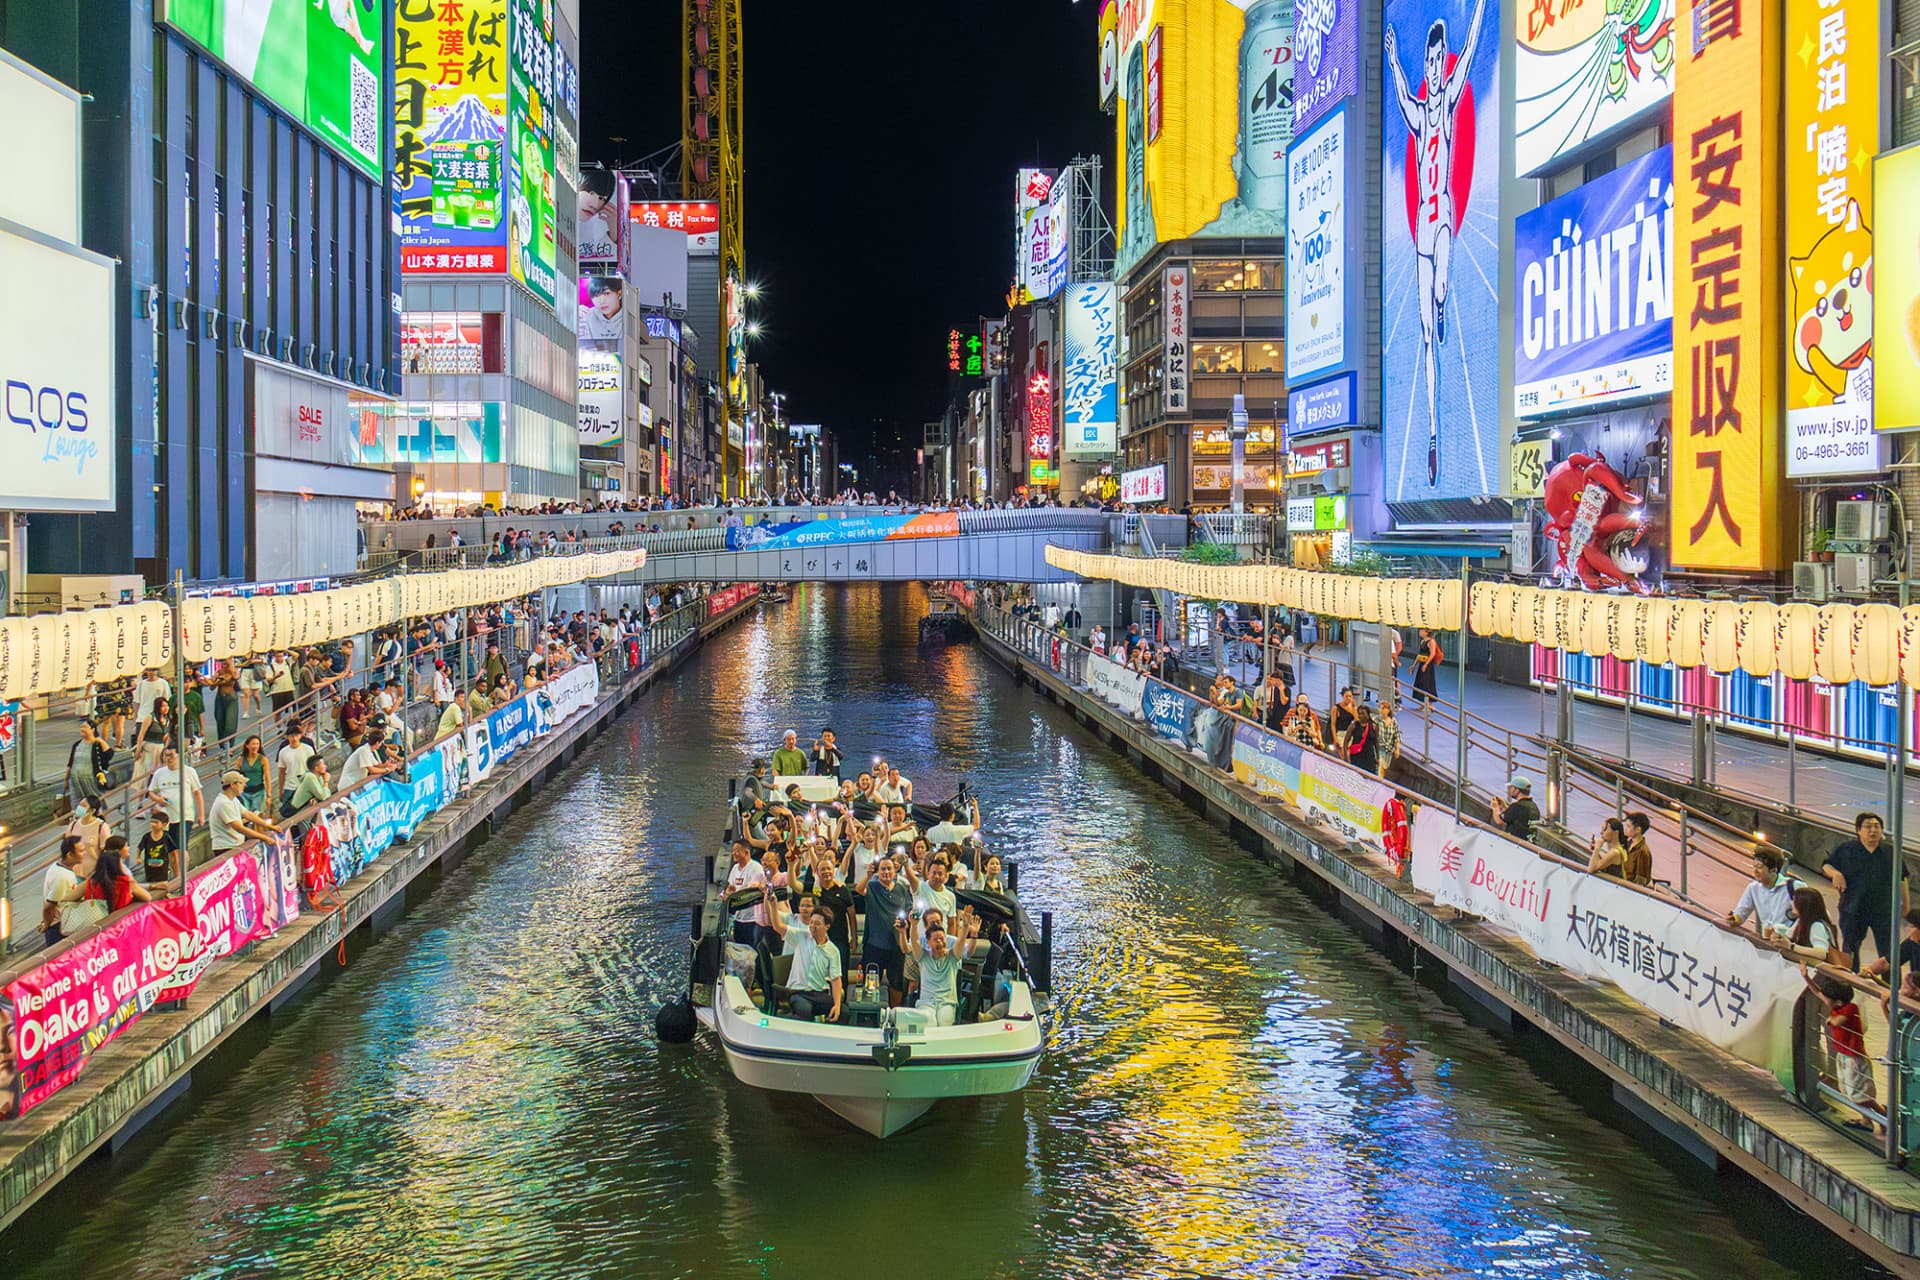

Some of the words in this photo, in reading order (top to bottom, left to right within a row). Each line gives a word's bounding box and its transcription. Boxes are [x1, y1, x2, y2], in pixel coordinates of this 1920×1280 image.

[467, 0, 505, 82] ぱれ
[435, 160, 489, 179] 大麦若葉
[1293, 132, 1339, 183] 創業100周年
[1427, 126, 1441, 224] グリコ
[643, 211, 684, 228] 免税
[407, 254, 494, 268] 山本漢方製薬
[1690, 110, 1742, 547] 安定収入
[299, 405, 322, 425] SALE
[1797, 415, 1869, 438] www.jsv.jp
[42, 421, 98, 475] Lounge
[1661, 437, 1668, 476] 2F
[1795, 441, 1870, 461] 06-4963-3661
[783, 559, 868, 572] えびす橋
[117, 617, 125, 670] PABLO
[140, 615, 148, 666] PABLO
[162, 610, 170, 659] PABLO
[203, 606, 212, 653] PABLO
[228, 605, 237, 650] PABLO
[1440, 840, 1465, 879] 美
[73, 968, 87, 986] to
[1566, 905, 1752, 1028] 大阪樟蔭女子大学
[20, 998, 89, 1061] Osaka
[93, 982, 110, 1017] is
[113, 962, 138, 1002] our
